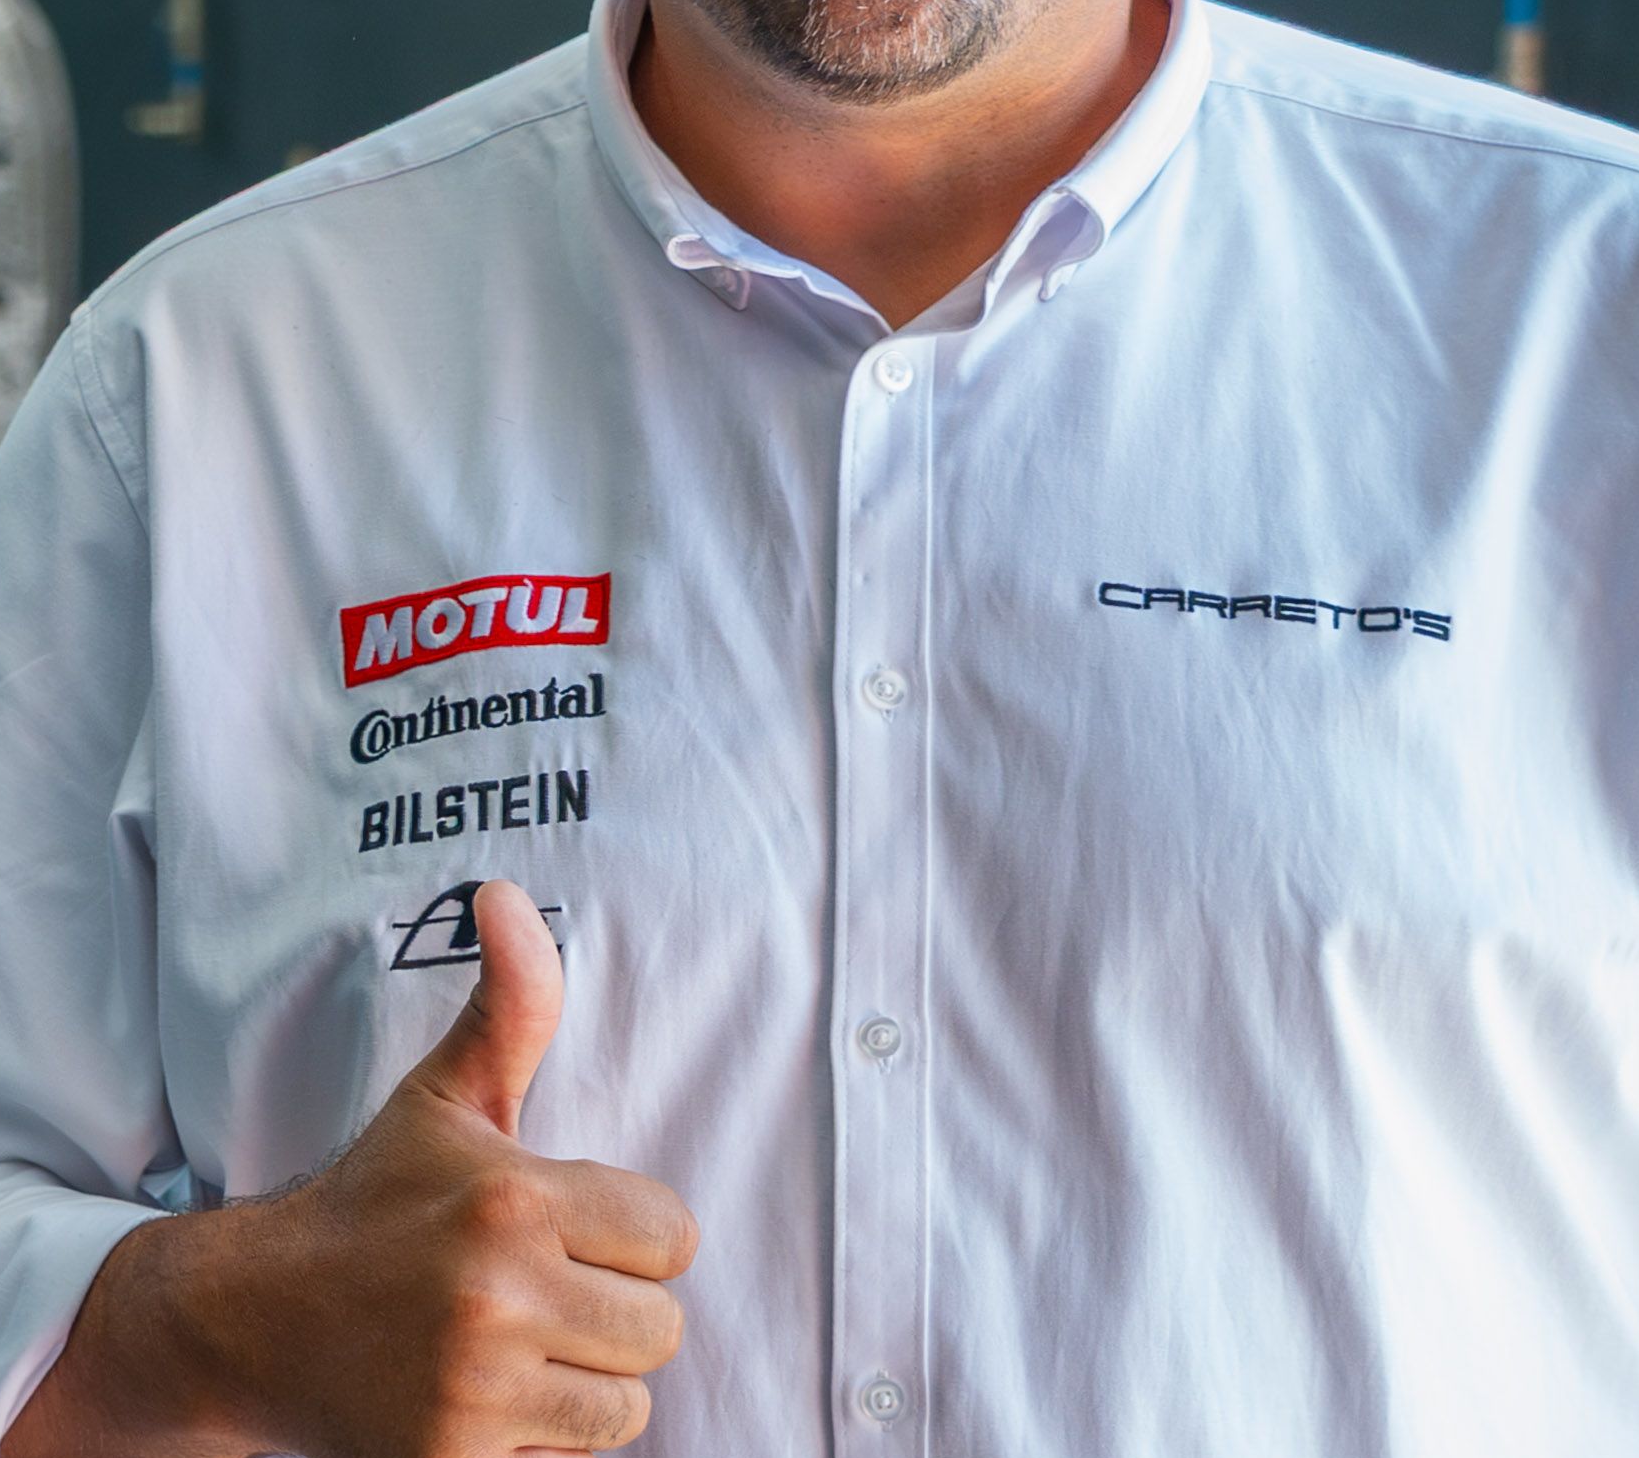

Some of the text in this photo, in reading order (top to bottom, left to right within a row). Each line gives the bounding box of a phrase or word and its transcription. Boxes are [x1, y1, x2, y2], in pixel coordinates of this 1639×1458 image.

[353, 585, 599, 671] MOTUL
[1098, 581, 1452, 642] CARRETO'S
[349, 673, 607, 764] Continental
[358, 769, 590, 853] BILSTEIN
